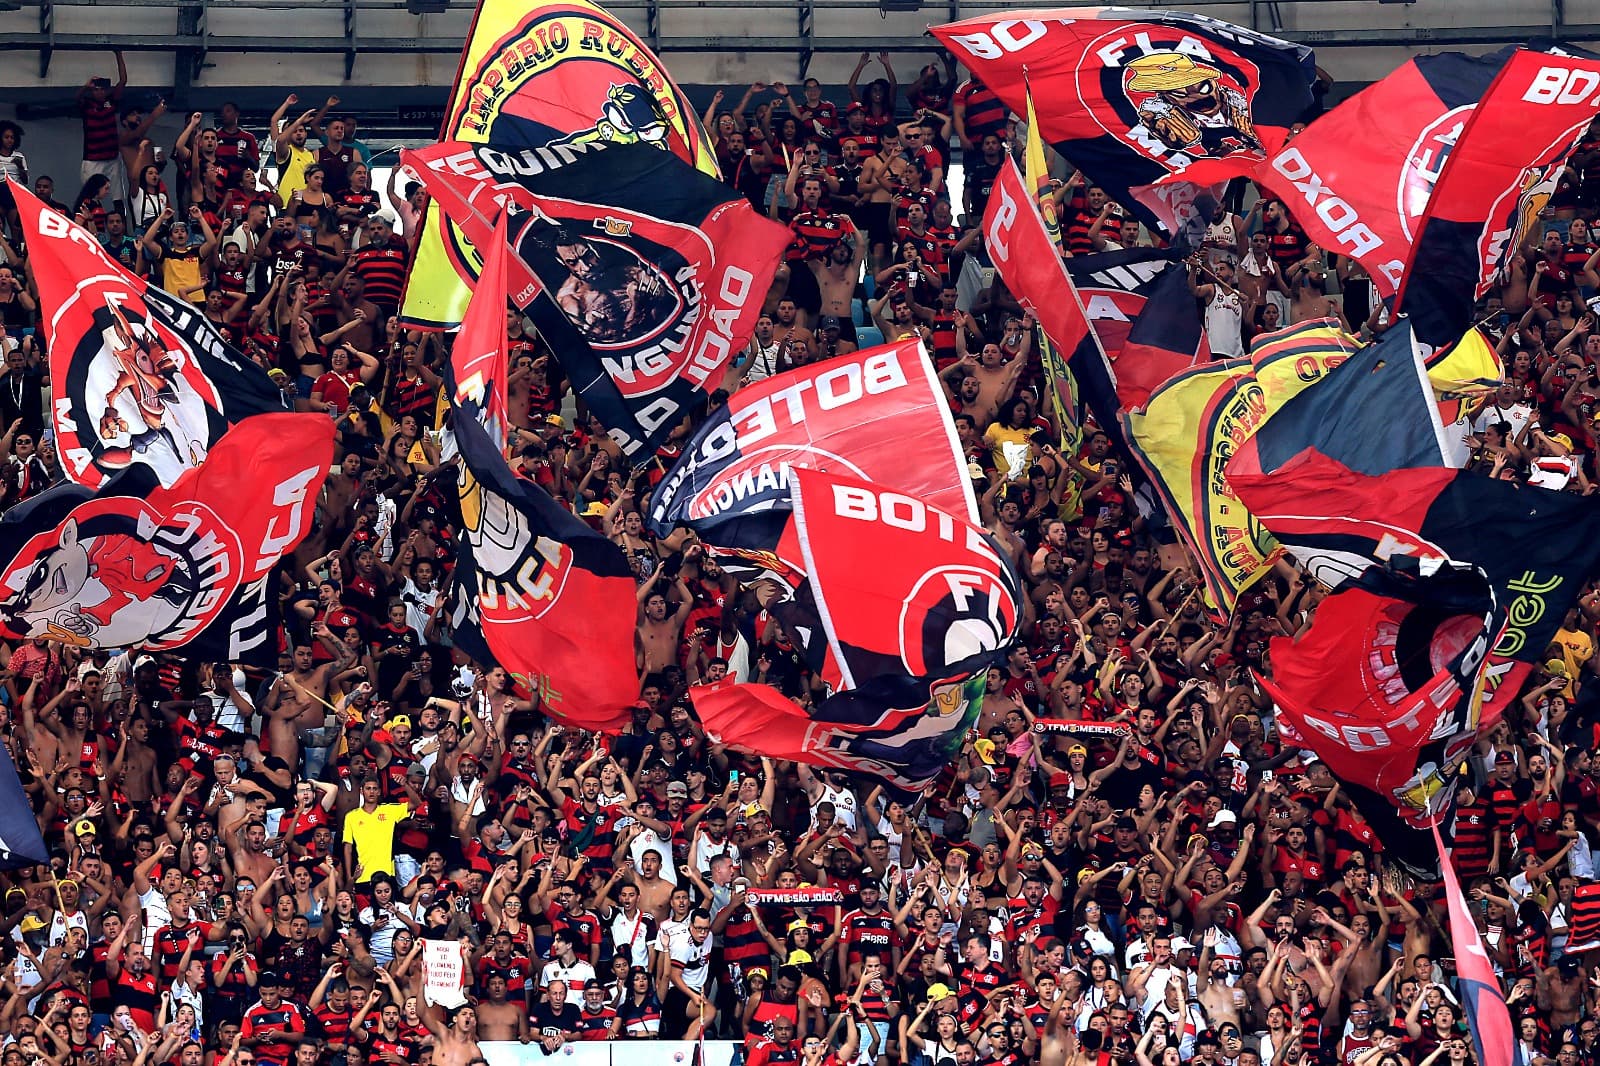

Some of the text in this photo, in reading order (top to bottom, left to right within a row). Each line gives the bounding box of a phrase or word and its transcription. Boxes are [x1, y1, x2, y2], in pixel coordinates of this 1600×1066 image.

[579, 21, 678, 120] RUBRO
[792, 889, 810, 902] SÃO
[811, 889, 833, 902] JOÃO
[870, 934, 889, 944] BRB
